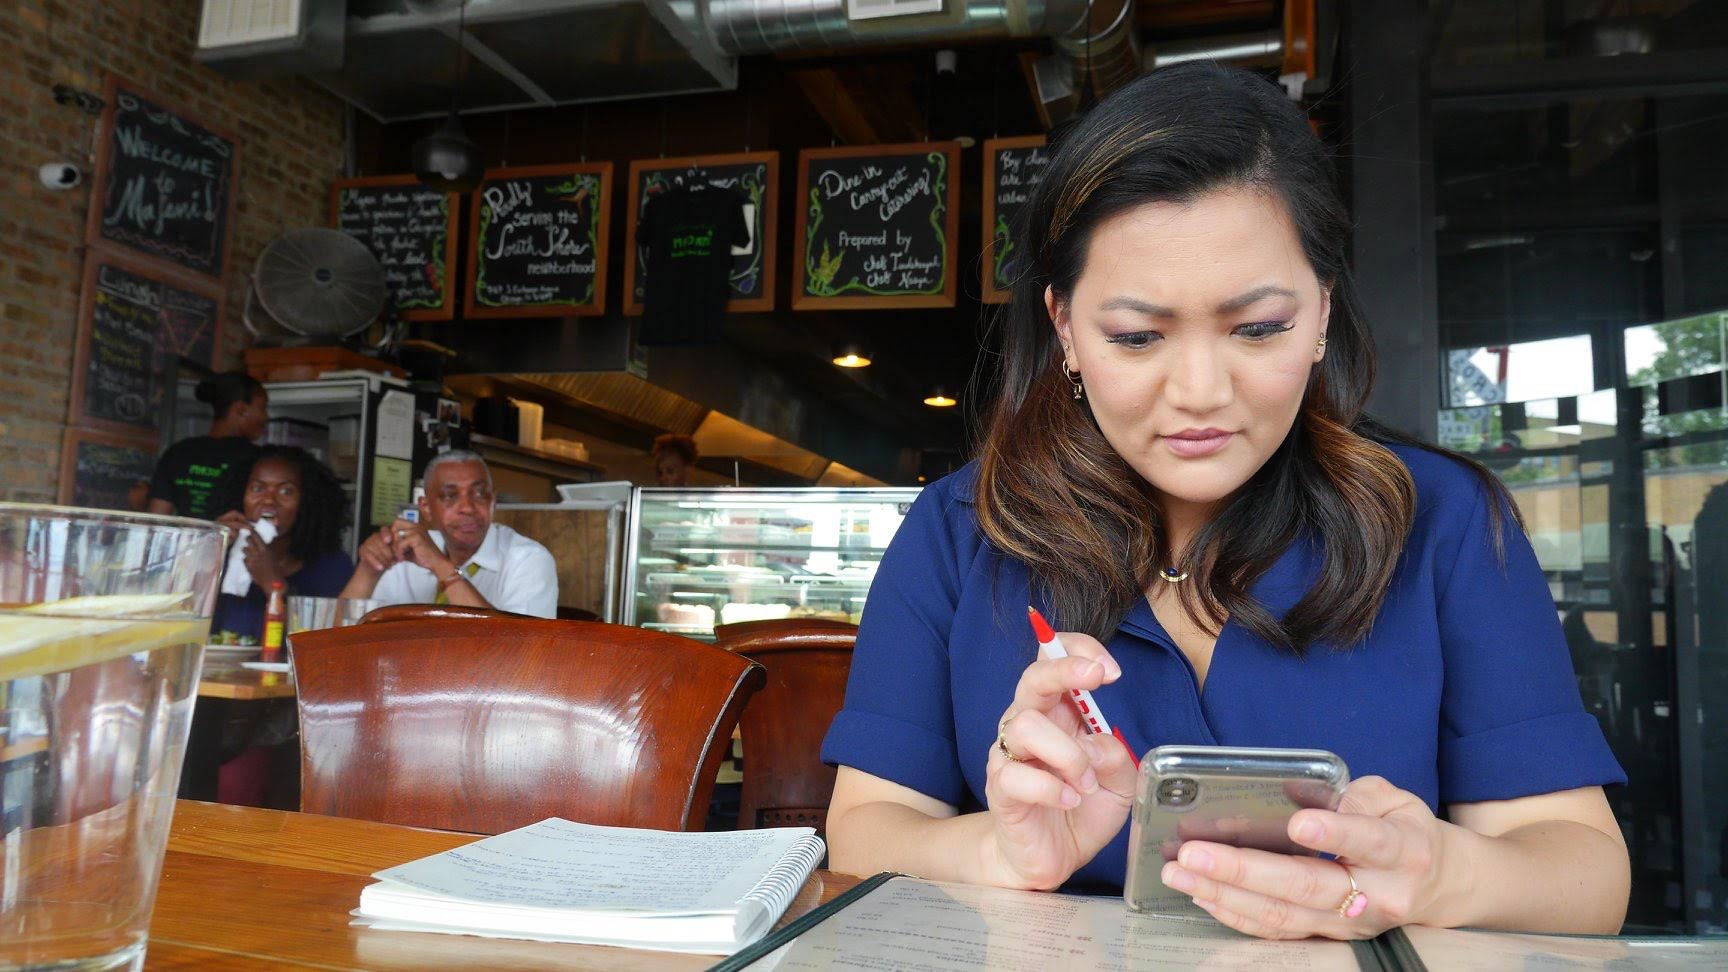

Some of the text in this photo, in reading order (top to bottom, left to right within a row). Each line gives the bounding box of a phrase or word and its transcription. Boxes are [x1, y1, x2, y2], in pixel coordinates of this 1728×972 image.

[116, 125, 216, 178] WELCOME
[557, 210, 579, 225] the
[485, 223, 537, 260] South
[838, 228, 912, 254] Prepared by
